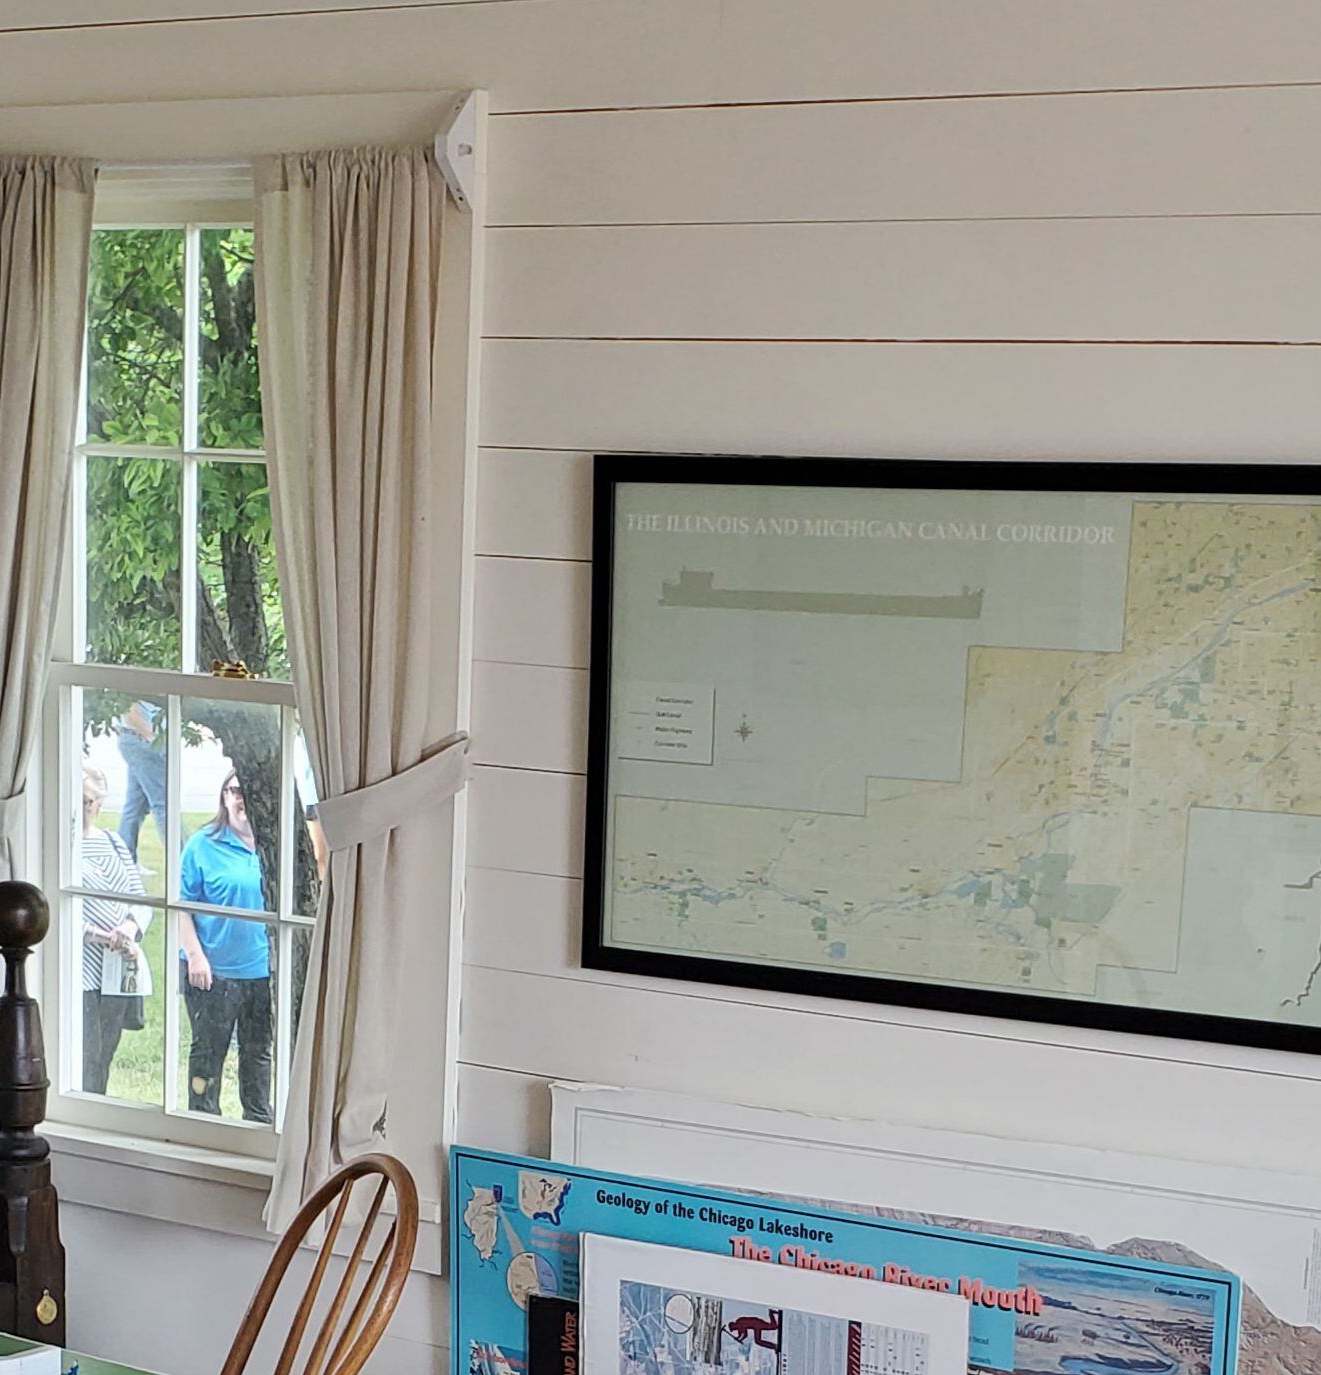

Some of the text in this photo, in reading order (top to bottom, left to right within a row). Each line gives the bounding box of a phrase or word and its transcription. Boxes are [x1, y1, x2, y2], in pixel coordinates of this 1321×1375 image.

[625, 513, 1115, 544] THE ILLINOIS AND MICHIGAN CANAL CORRIDOR
[596, 1189, 834, 1244] Geology of the Chicago Lakeshore
[729, 1235, 772, 1263] The
[958, 1275, 1043, 1316] Mouth
